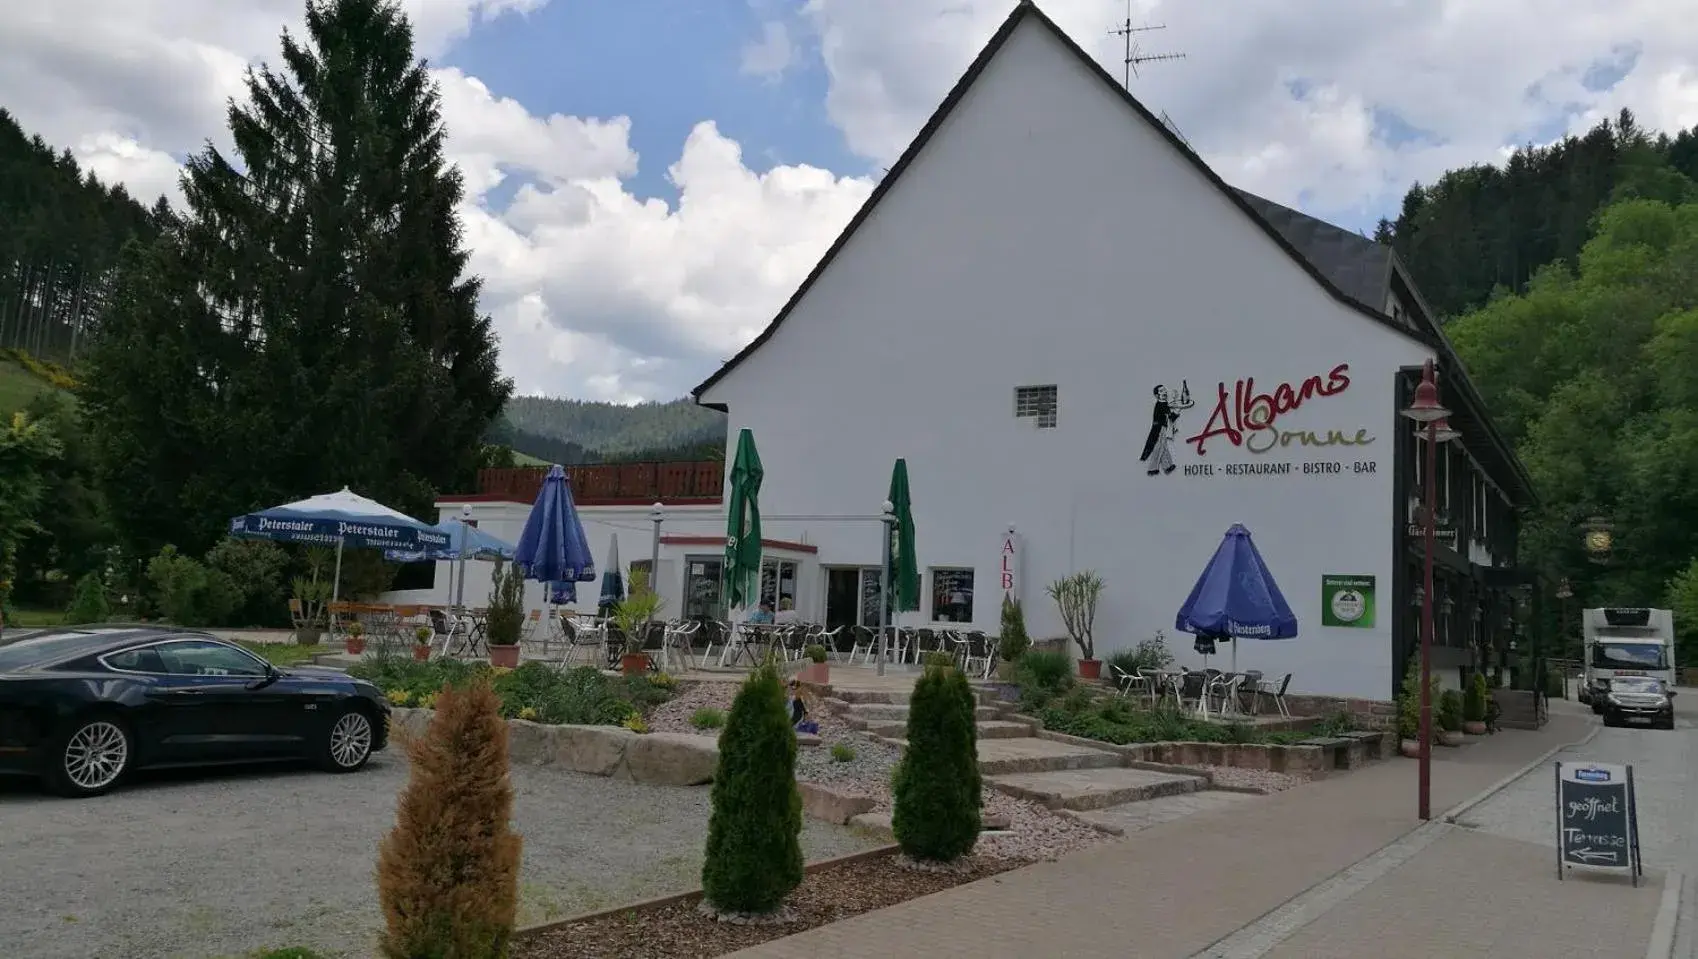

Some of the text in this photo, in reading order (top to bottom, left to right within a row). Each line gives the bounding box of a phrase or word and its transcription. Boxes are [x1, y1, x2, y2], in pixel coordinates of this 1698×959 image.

[1186, 363, 1350, 456] Albans
[1246, 405, 1376, 454] Sonne
[1184, 461, 1377, 476] HOTEL RESTAURANT BISTRO BAR
[258, 517, 314, 532] Peterstaler
[337, 521, 399, 539] Peterstaler
[1567, 796, 1621, 820] geöffnet
